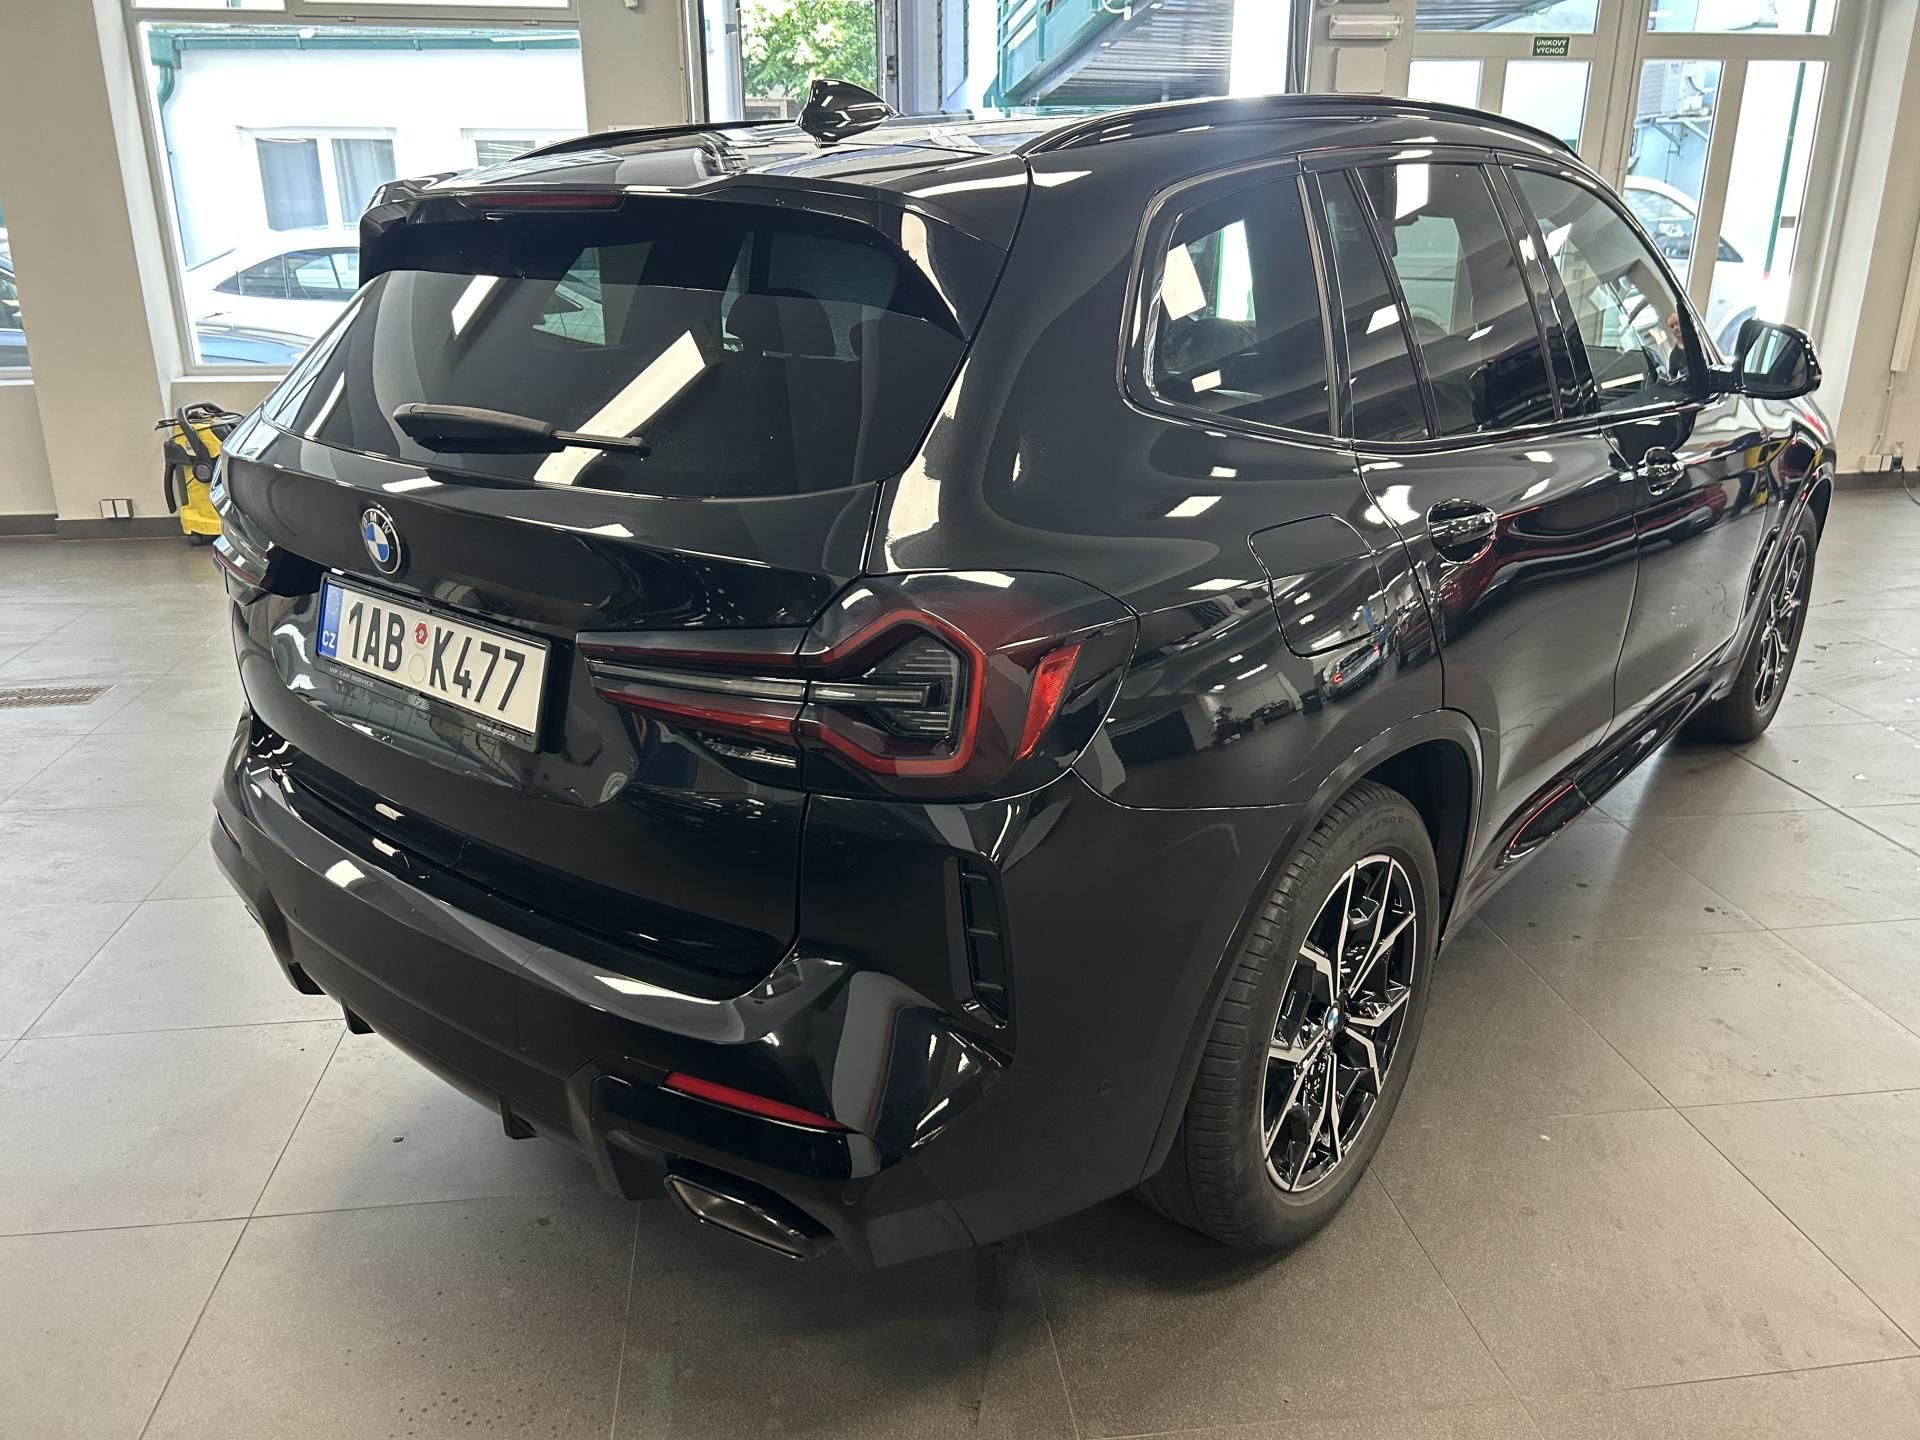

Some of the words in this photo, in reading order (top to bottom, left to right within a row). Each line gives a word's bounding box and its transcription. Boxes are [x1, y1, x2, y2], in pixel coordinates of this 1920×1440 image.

[1536, 38, 1567, 46] ÚNIKOVÝ
[1536, 46, 1565, 54] VÝCHOD
[362, 511, 393, 535] BMW
[322, 630, 337, 649] CZ
[348, 601, 406, 672] 1AB
[429, 627, 526, 712] K477
[339, 670, 350, 679] CAR
[351, 674, 374, 688] SERVICE
